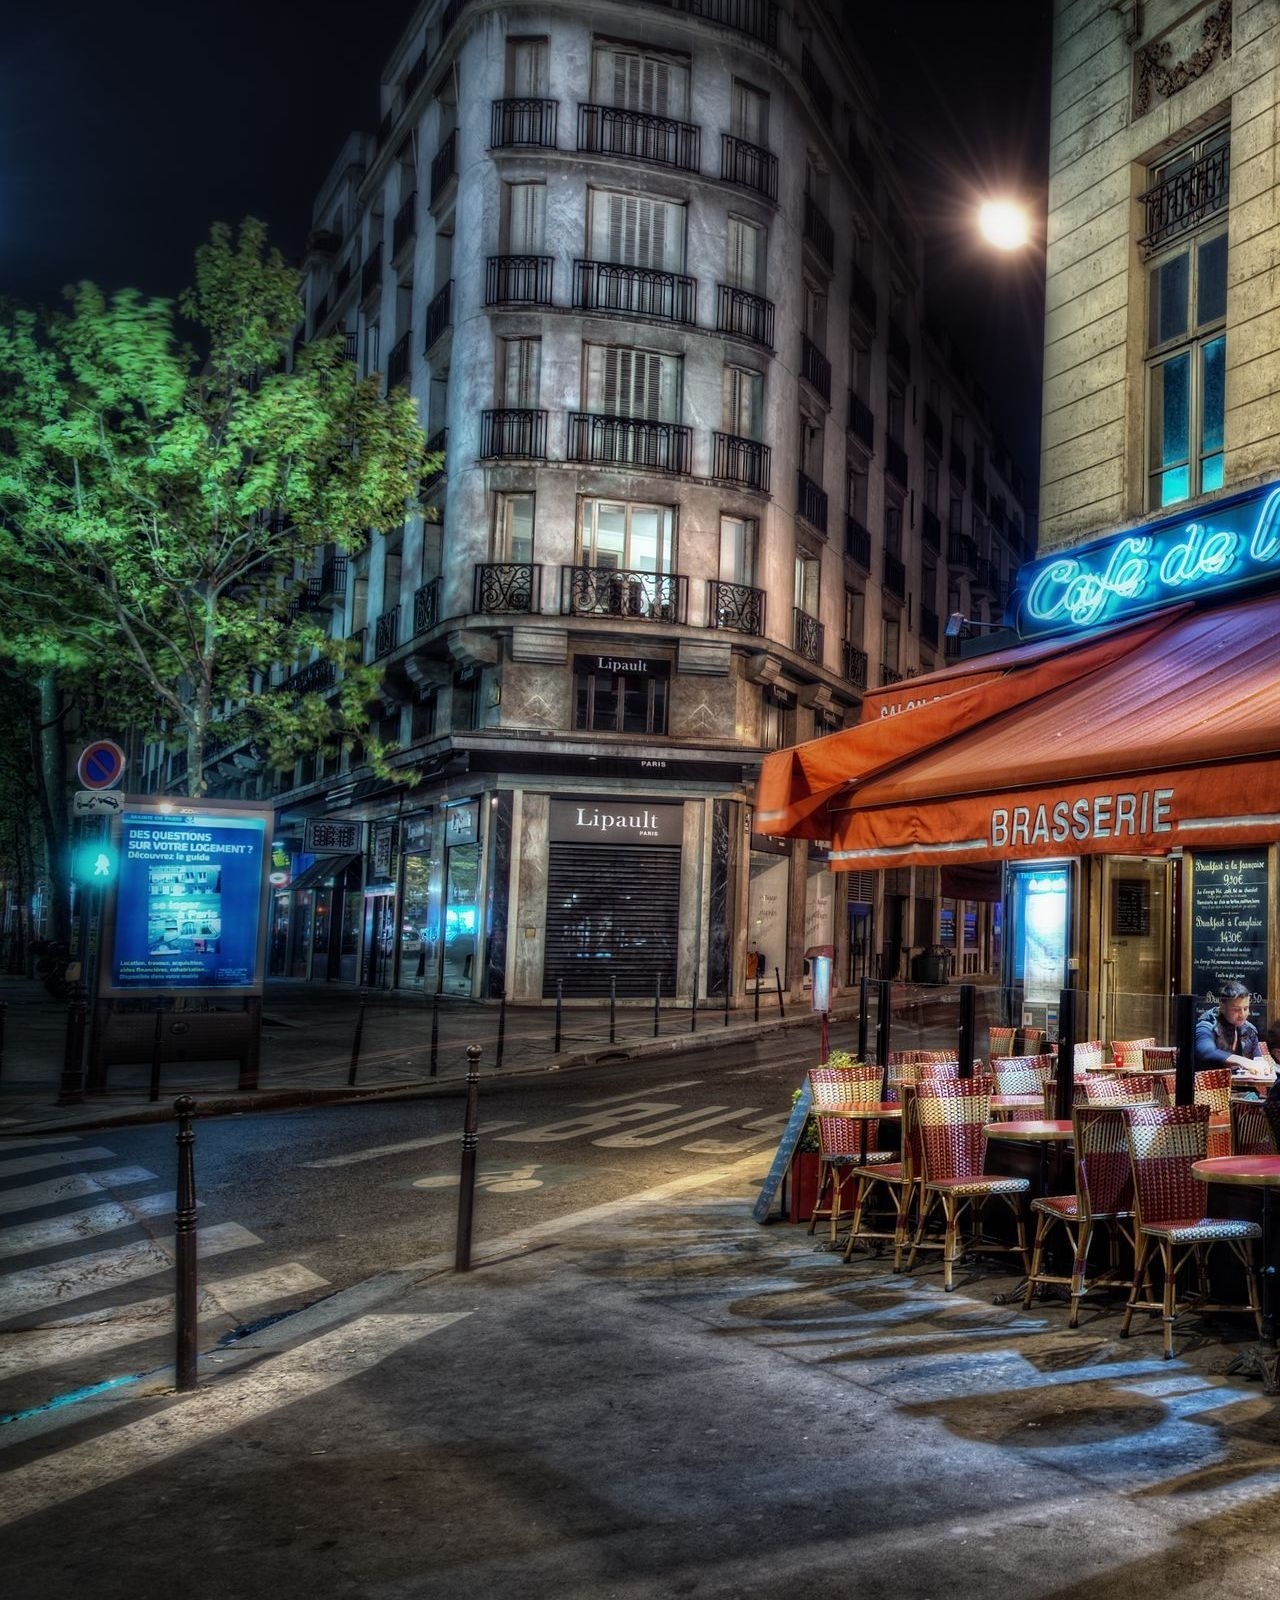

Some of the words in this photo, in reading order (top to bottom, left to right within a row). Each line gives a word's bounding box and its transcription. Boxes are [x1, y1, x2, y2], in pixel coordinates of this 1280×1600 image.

[1027, 537, 1152, 626] Café
[1160, 523, 1240, 586] de
[598, 657, 648, 673] Lipault
[641, 760, 666, 768] PARIS
[575, 807, 659, 831] Lipault
[990, 788, 1175, 848] BRASSERIE
[129, 829, 150, 839] DES
[152, 831, 212, 842] QUESTIONS
[128, 841, 151, 850] SUR
[153, 842, 188, 852] VOTRE
[190, 843, 245, 854] LOGEMENT
[247, 845, 254, 854] ?
[128, 851, 173, 860] Découvrez
[176, 852, 185, 860] le
[186, 853, 210, 862] guide
[492, 1102, 791, 1154] BUS
